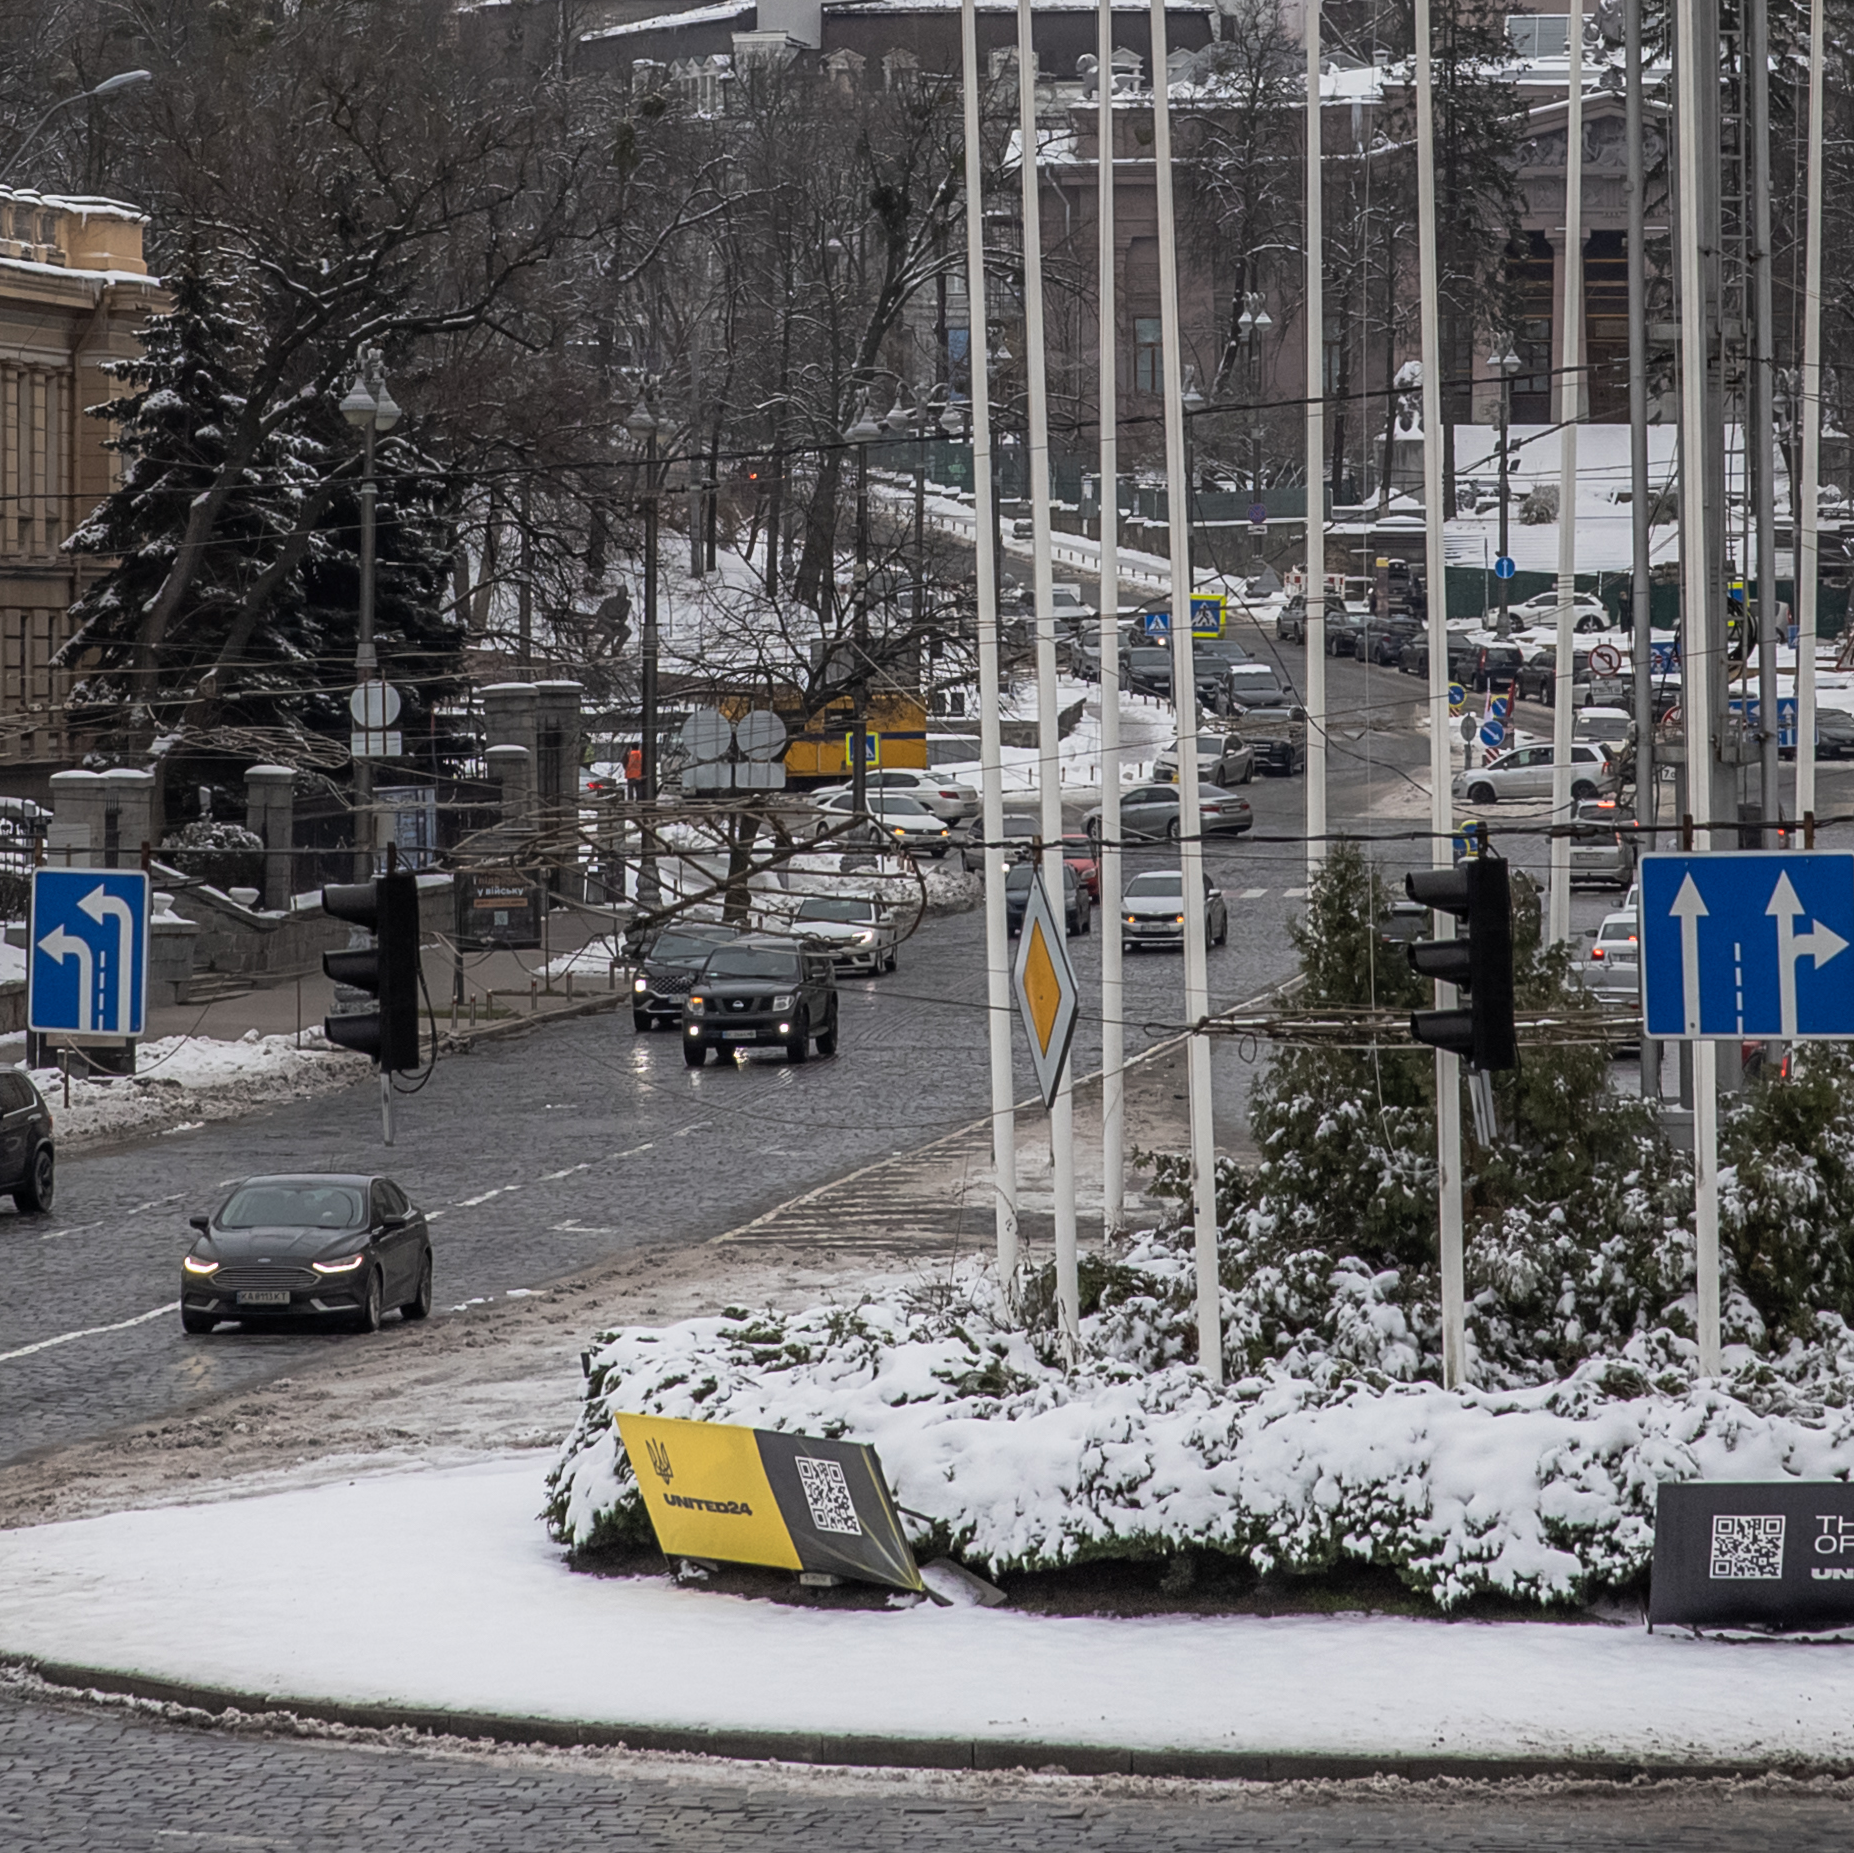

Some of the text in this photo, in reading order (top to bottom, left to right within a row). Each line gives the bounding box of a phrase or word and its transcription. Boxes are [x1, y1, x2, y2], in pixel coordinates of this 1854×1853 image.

[477, 885, 524, 898] у війську
[663, 1492, 753, 1516] UNITED24
